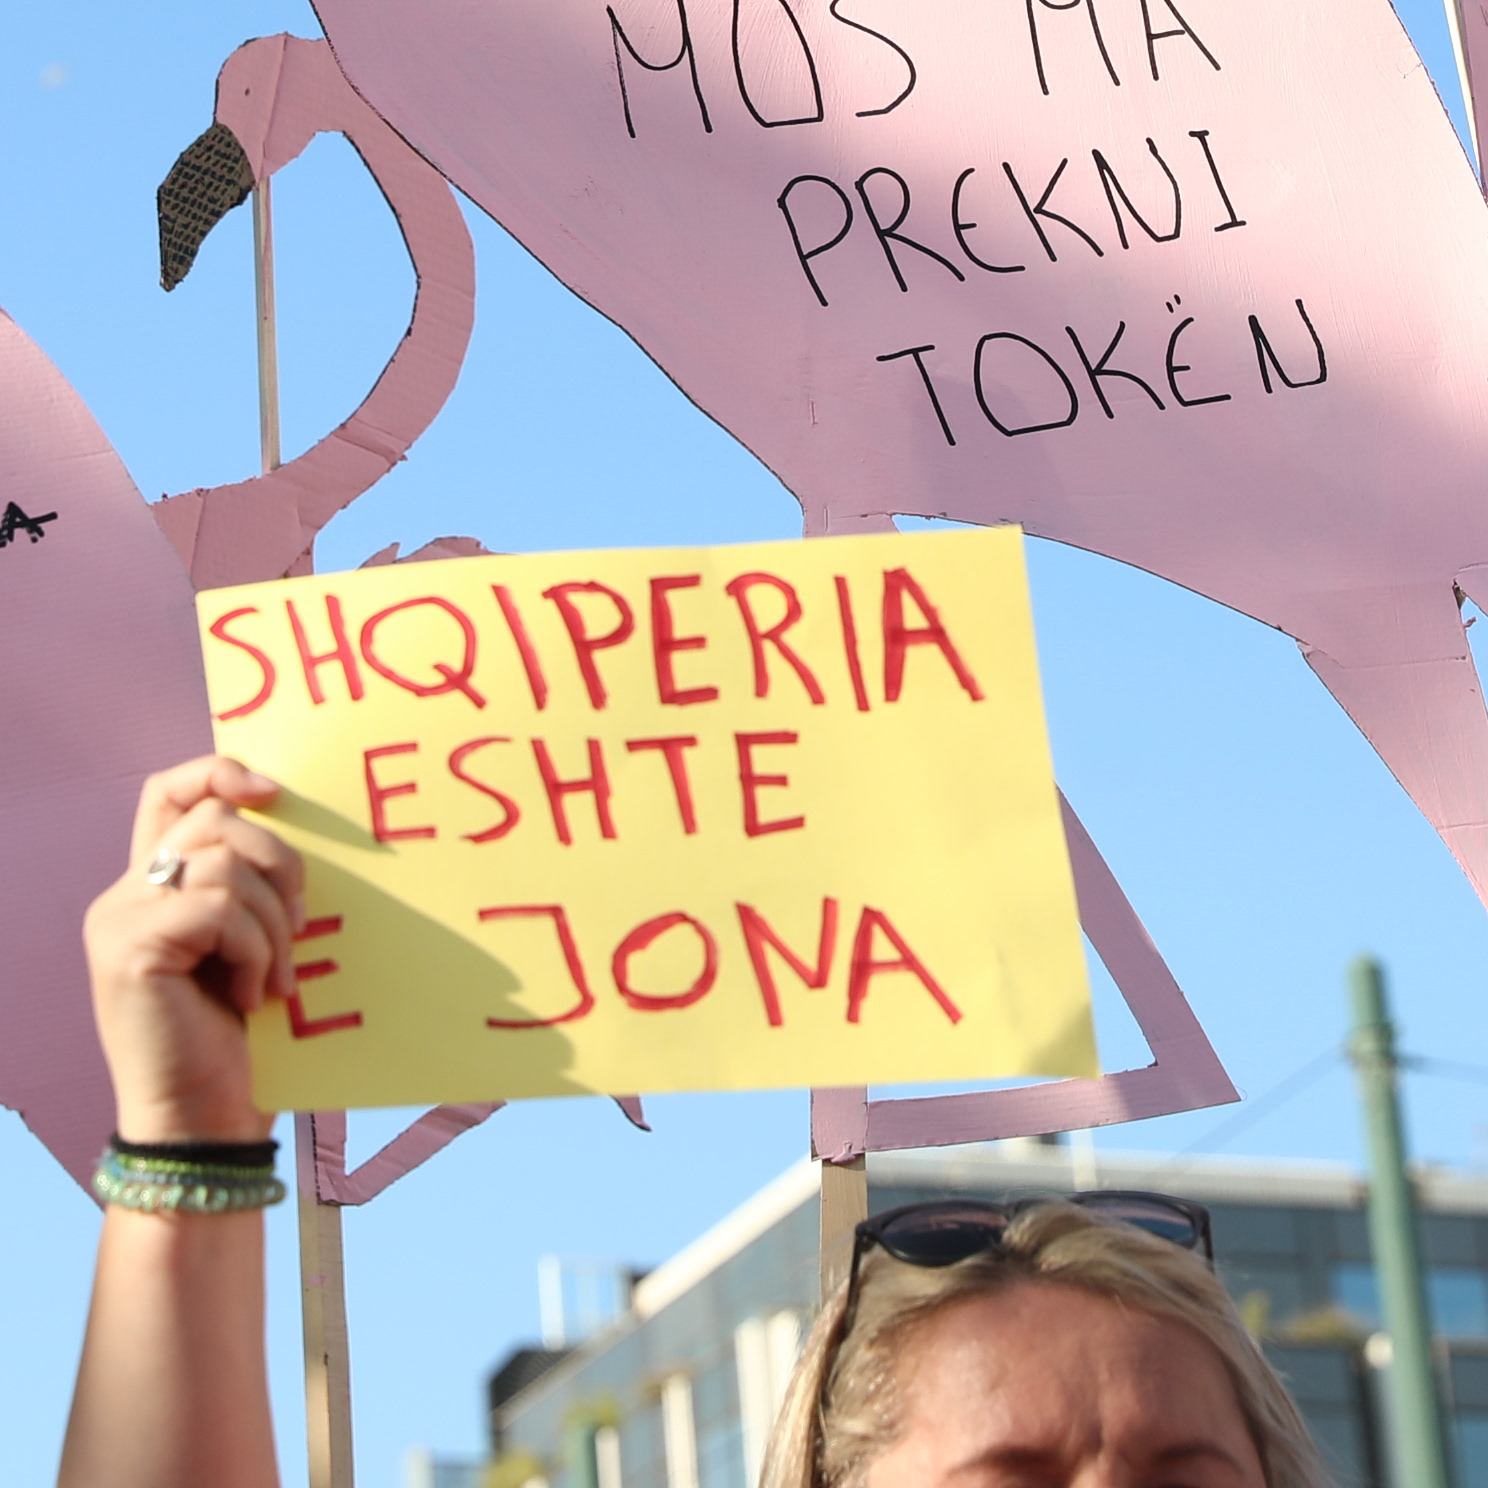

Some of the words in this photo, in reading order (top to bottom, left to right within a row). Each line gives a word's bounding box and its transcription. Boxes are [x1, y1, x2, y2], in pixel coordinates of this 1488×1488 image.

[777, 130, 1247, 308] PREKNI
[876, 295, 1327, 446] TOKËN
[209, 567, 985, 722] SHQIPERIA
[364, 731, 805, 846] ESHTE
[285, 916, 363, 1040] E
[478, 897, 963, 1030] JONA
